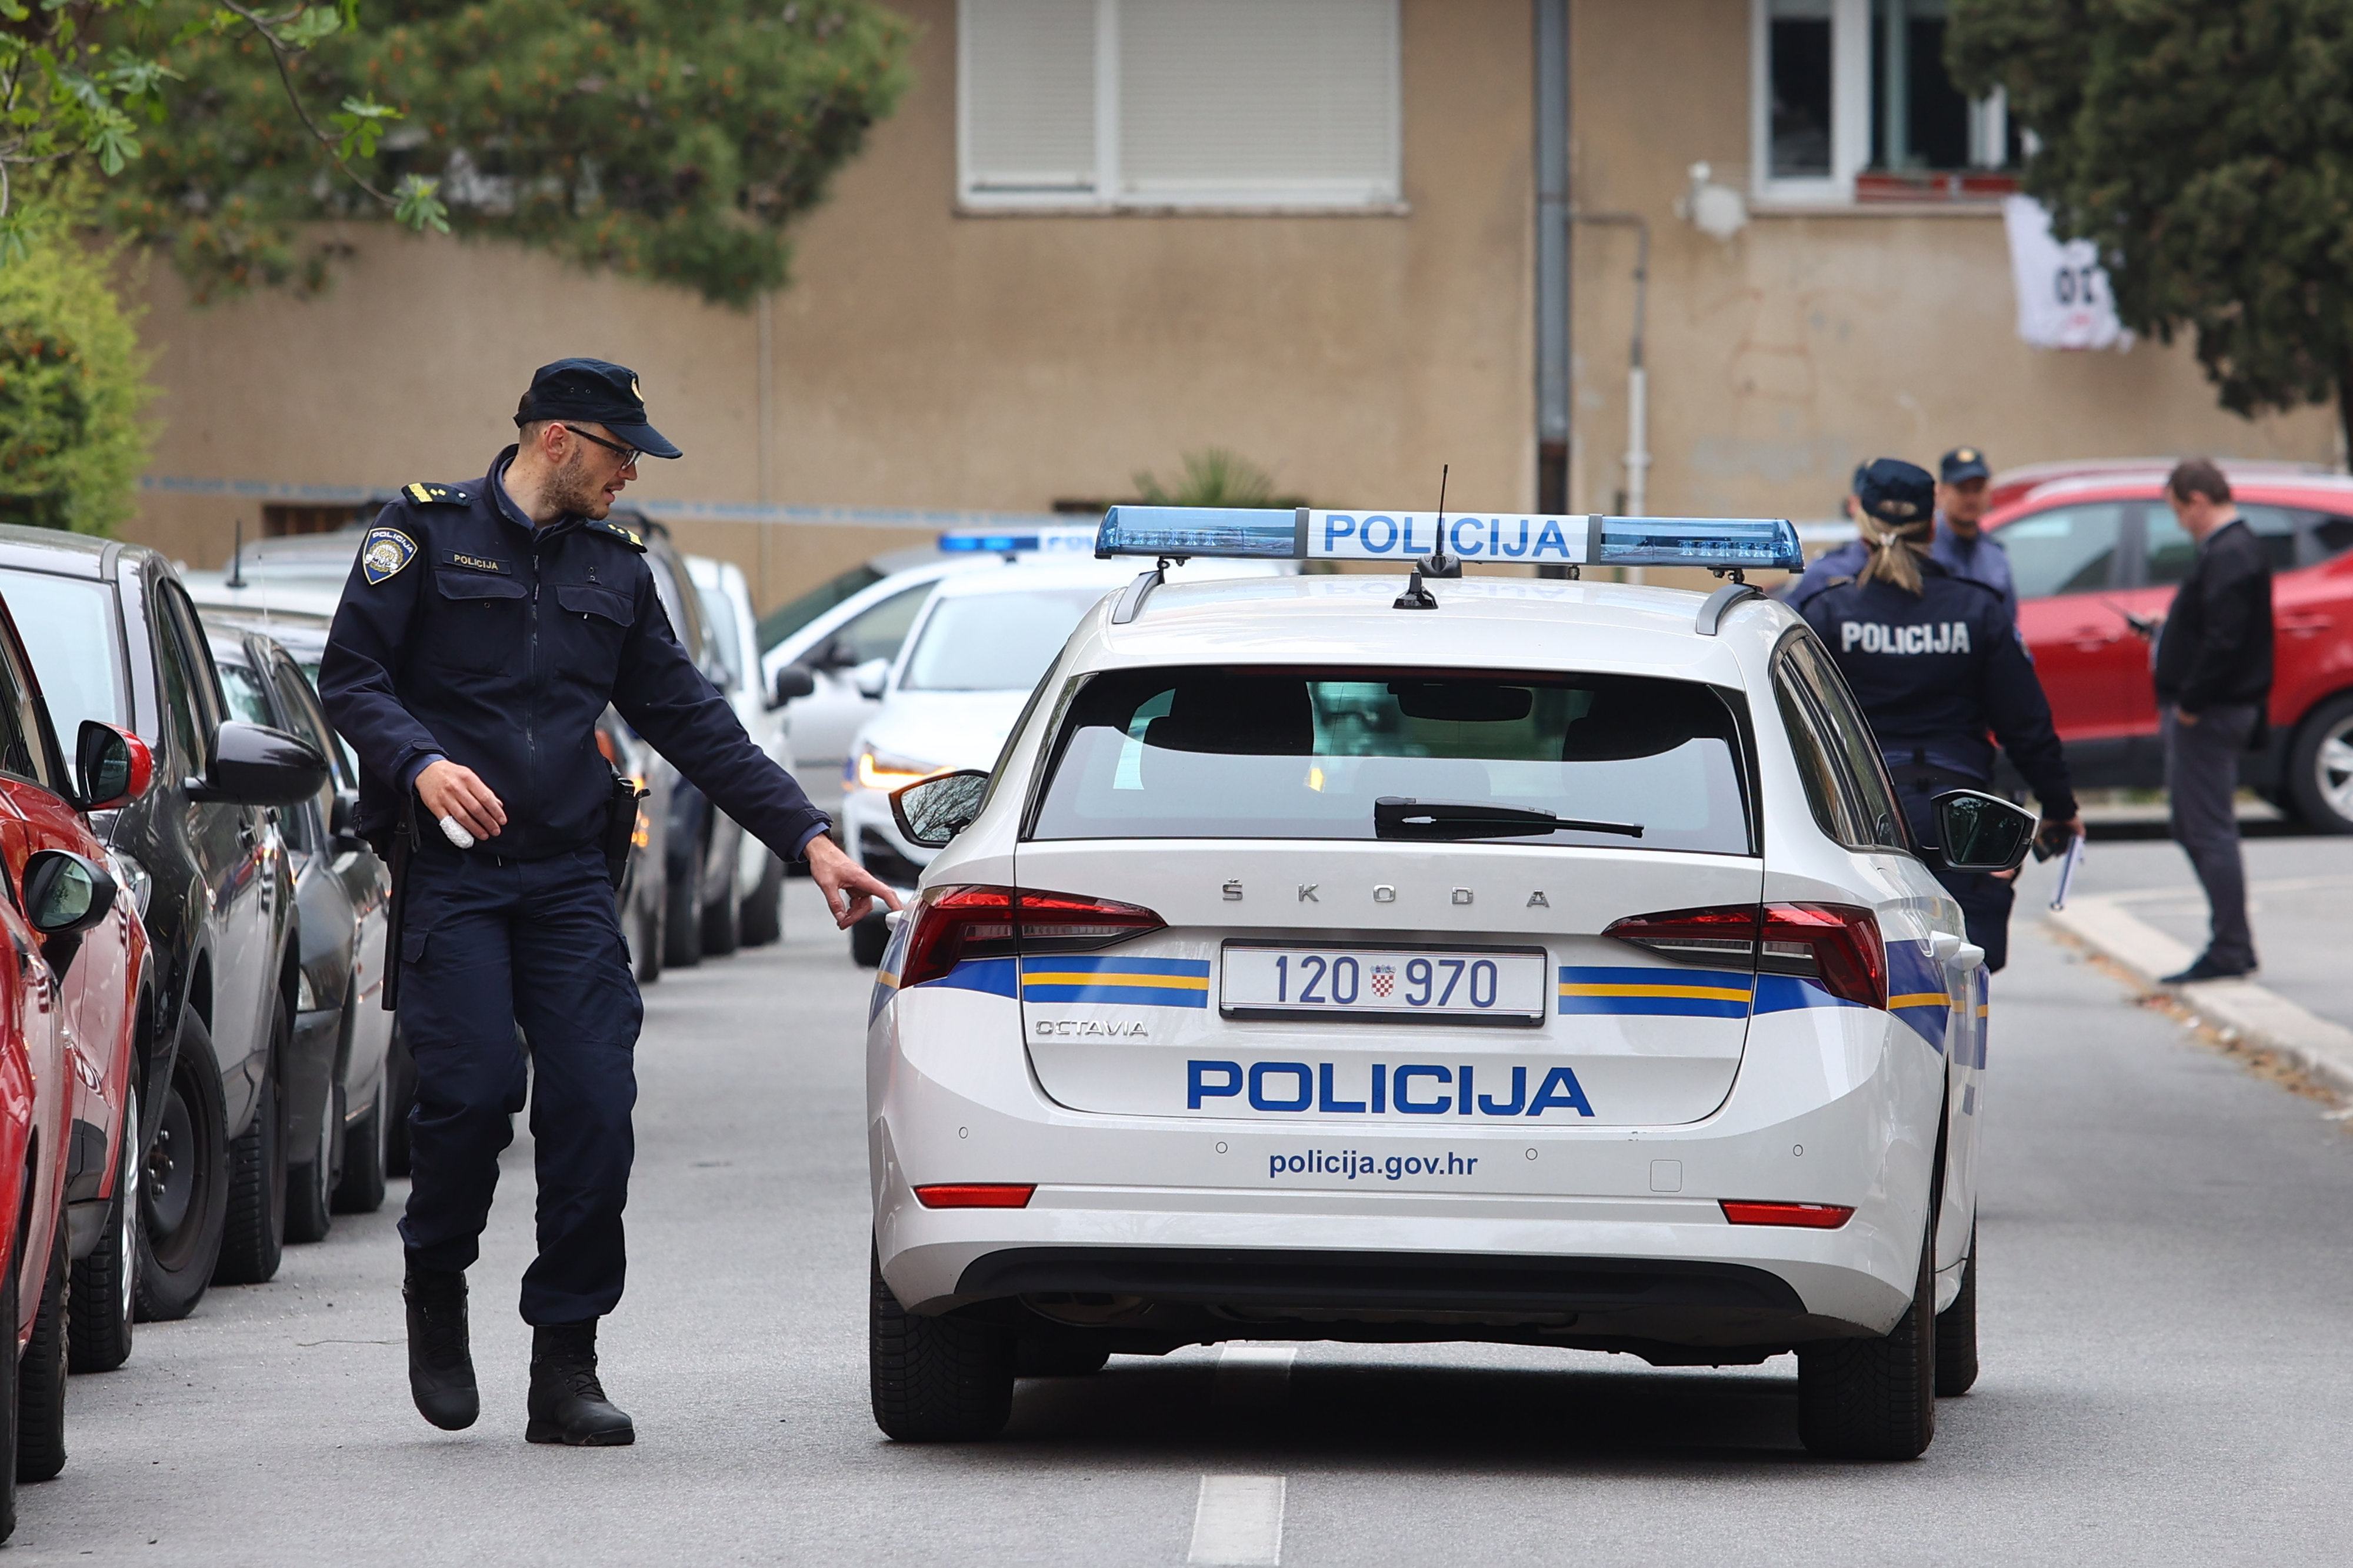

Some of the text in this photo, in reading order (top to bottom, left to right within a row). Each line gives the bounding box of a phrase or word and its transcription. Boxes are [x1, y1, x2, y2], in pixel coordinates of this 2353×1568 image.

[372, 531, 414, 553] POLICIJA
[454, 554, 499, 571] POLICIJA
[1841, 620, 1971, 655] POLICIJA
[1222, 878, 1550, 909] ŠKODA
[1276, 955, 1498, 1008] 120 970
[1035, 1020, 1149, 1037] OCTAVIA
[1187, 1060, 1595, 1117] POLICIJA
[1269, 1150, 1479, 1181] policija.gov.hr
